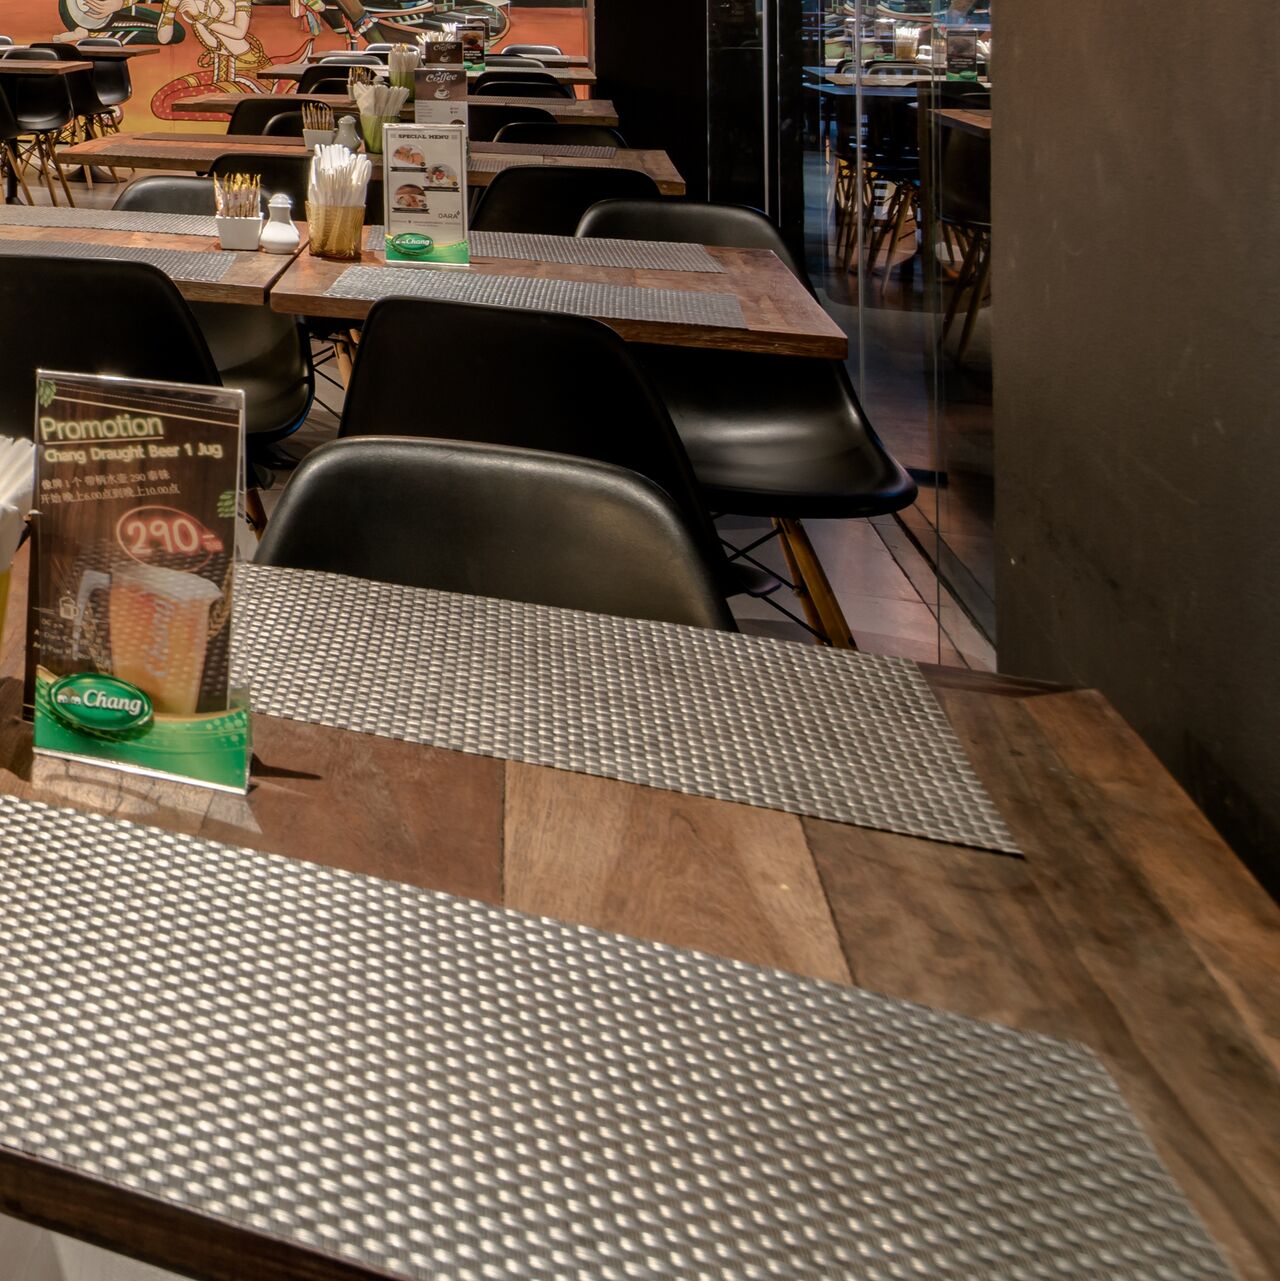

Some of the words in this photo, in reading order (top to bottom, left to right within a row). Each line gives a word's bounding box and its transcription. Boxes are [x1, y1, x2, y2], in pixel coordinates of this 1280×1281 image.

[425, 72, 458, 84] Coffee
[406, 237, 430, 246] Chang
[40, 414, 164, 441] Promotion
[44, 448, 87, 464] Chang
[90, 445, 144, 462] Draught
[148, 443, 180, 458] Beer
[183, 442, 193, 456] 1
[197, 442, 224, 459] Jug
[83, 689, 142, 716] Chang
